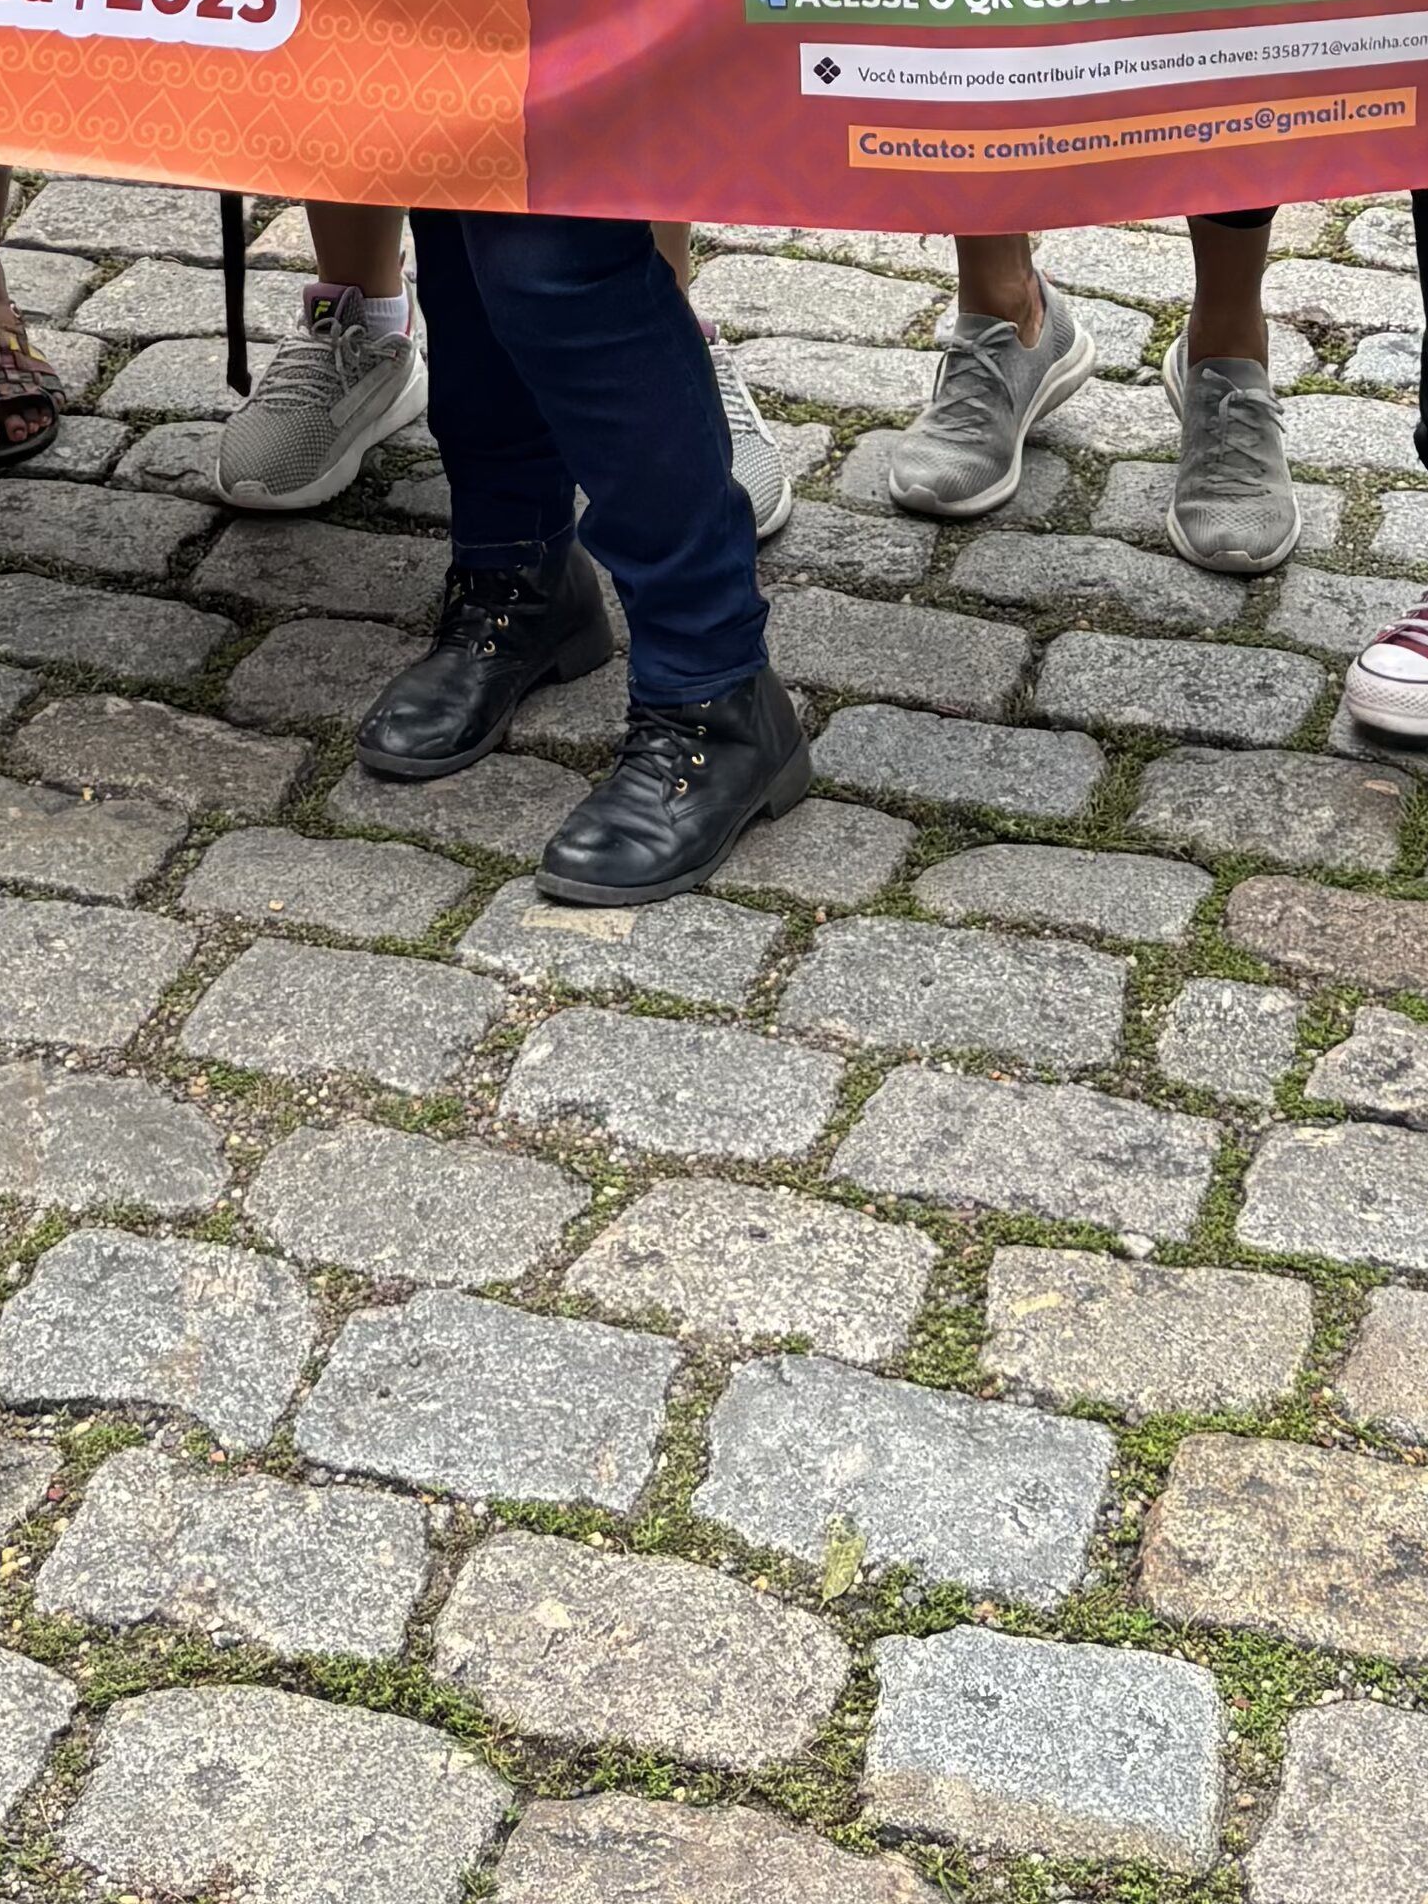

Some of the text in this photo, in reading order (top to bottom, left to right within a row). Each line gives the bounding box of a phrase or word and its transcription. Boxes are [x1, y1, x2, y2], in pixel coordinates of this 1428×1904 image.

[857, 66, 896, 83] Você
[899, 69, 963, 85] também
[966, 70, 1005, 87] pode
[1008, 64, 1085, 84] contribuir
[1088, 61, 1112, 78] via
[1113, 59, 1138, 75] Pix
[1140, 51, 1195, 72] usando
[1197, 54, 1207, 66] a
[1210, 47, 1259, 65] chave:
[859, 98, 1406, 159] Contato: comiteam.mmnegras@gmail.com
